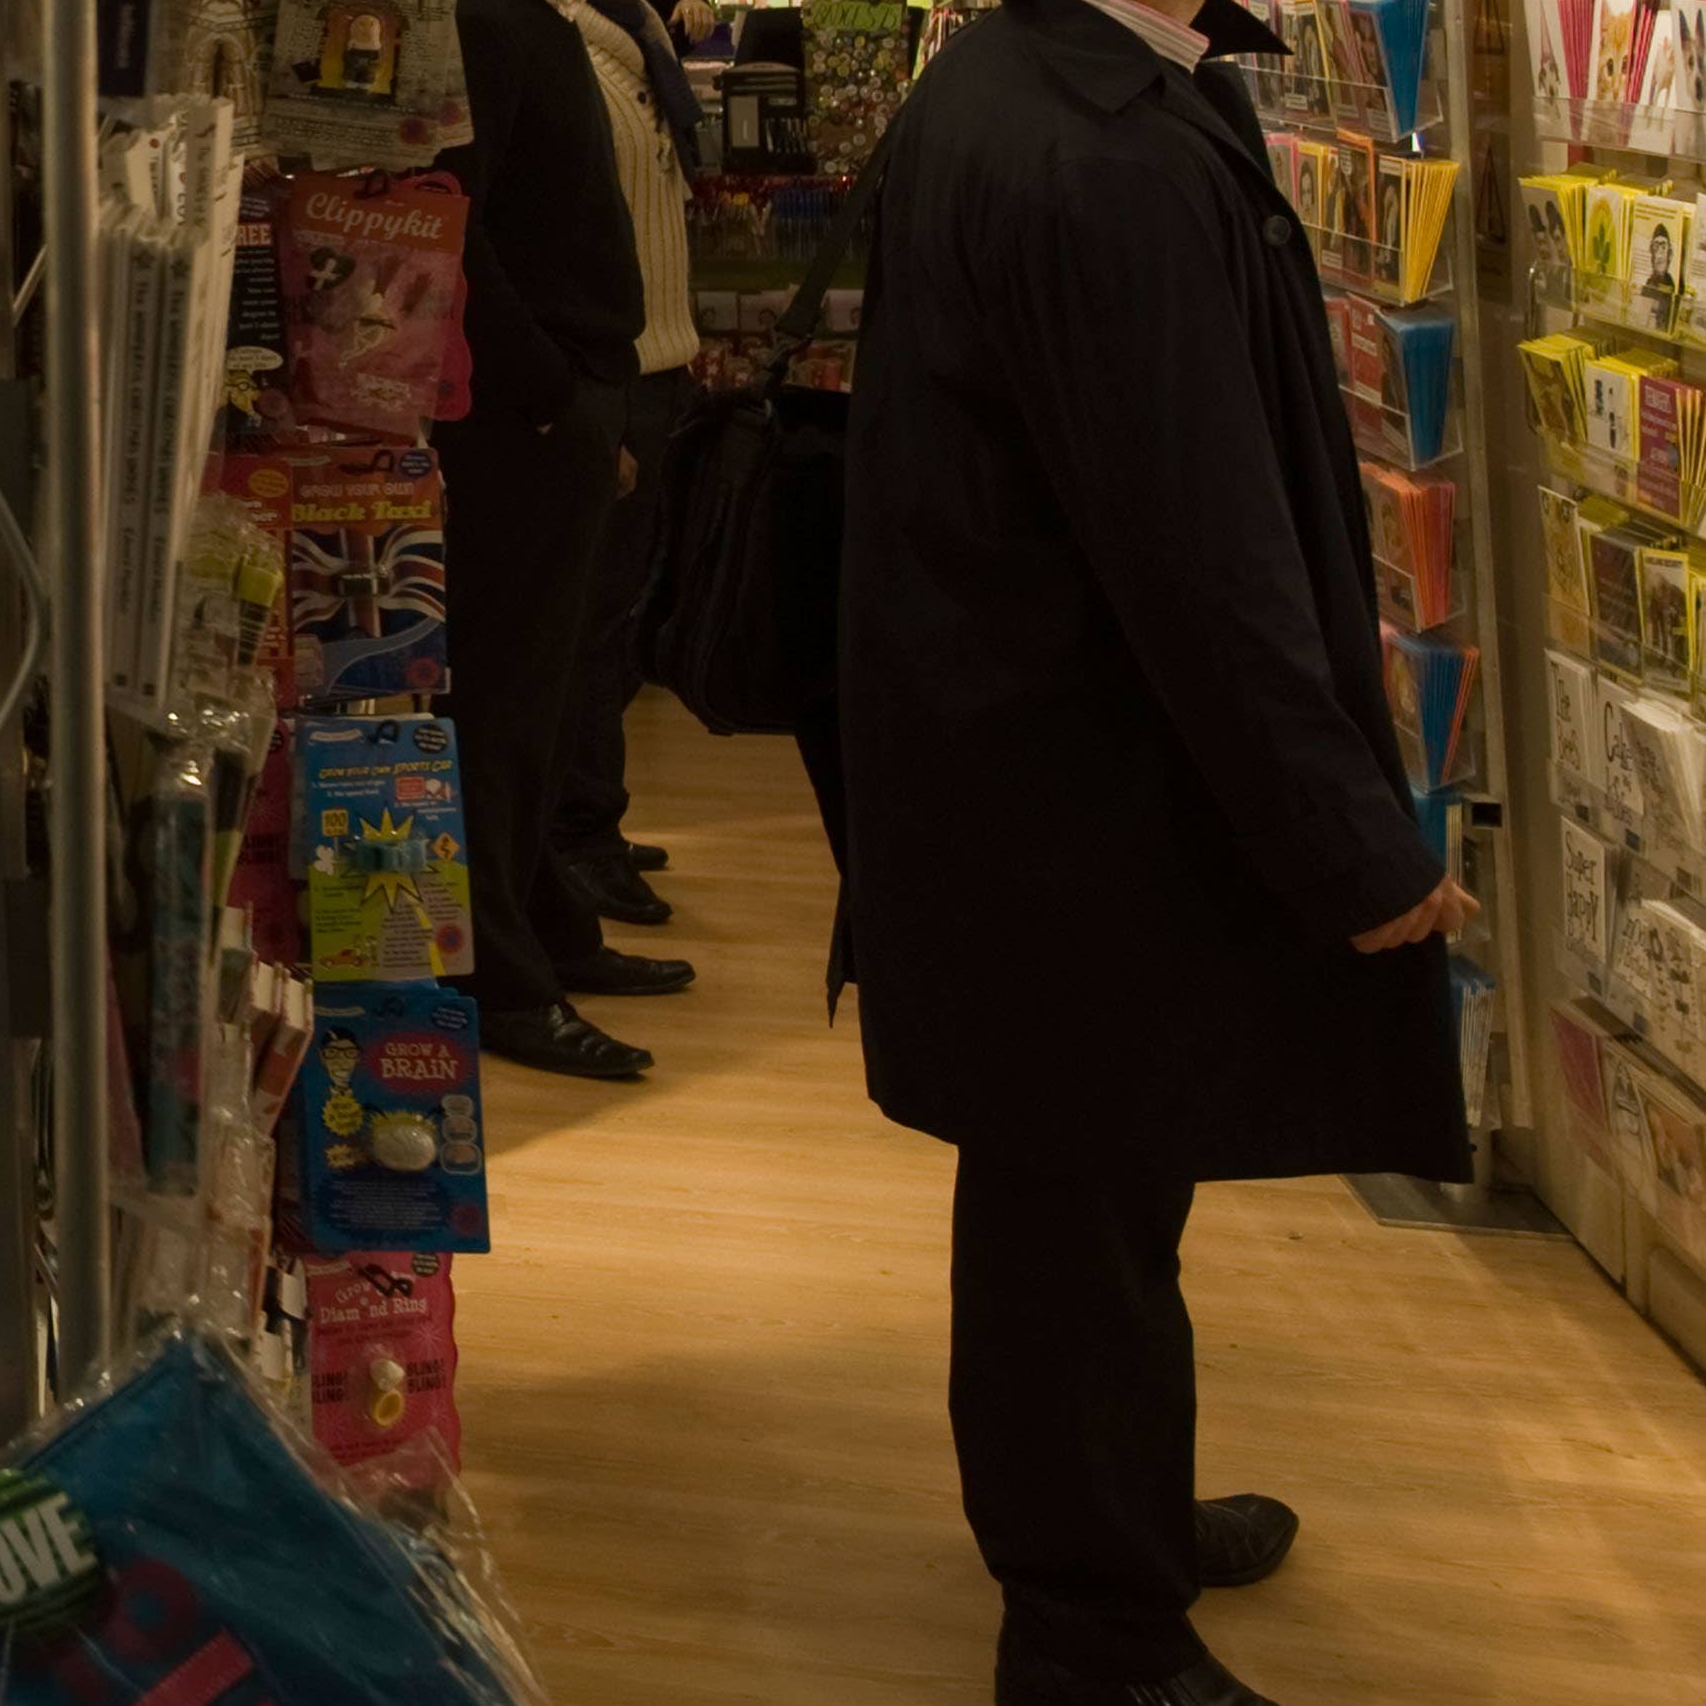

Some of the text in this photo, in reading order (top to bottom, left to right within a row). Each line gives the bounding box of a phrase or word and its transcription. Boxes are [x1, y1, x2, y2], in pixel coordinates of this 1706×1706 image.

[304, 193, 445, 242] Clippykit
[235, 222, 273, 247] REE
[290, 498, 434, 524] Black Taxi
[383, 1041, 451, 1059] GROW A
